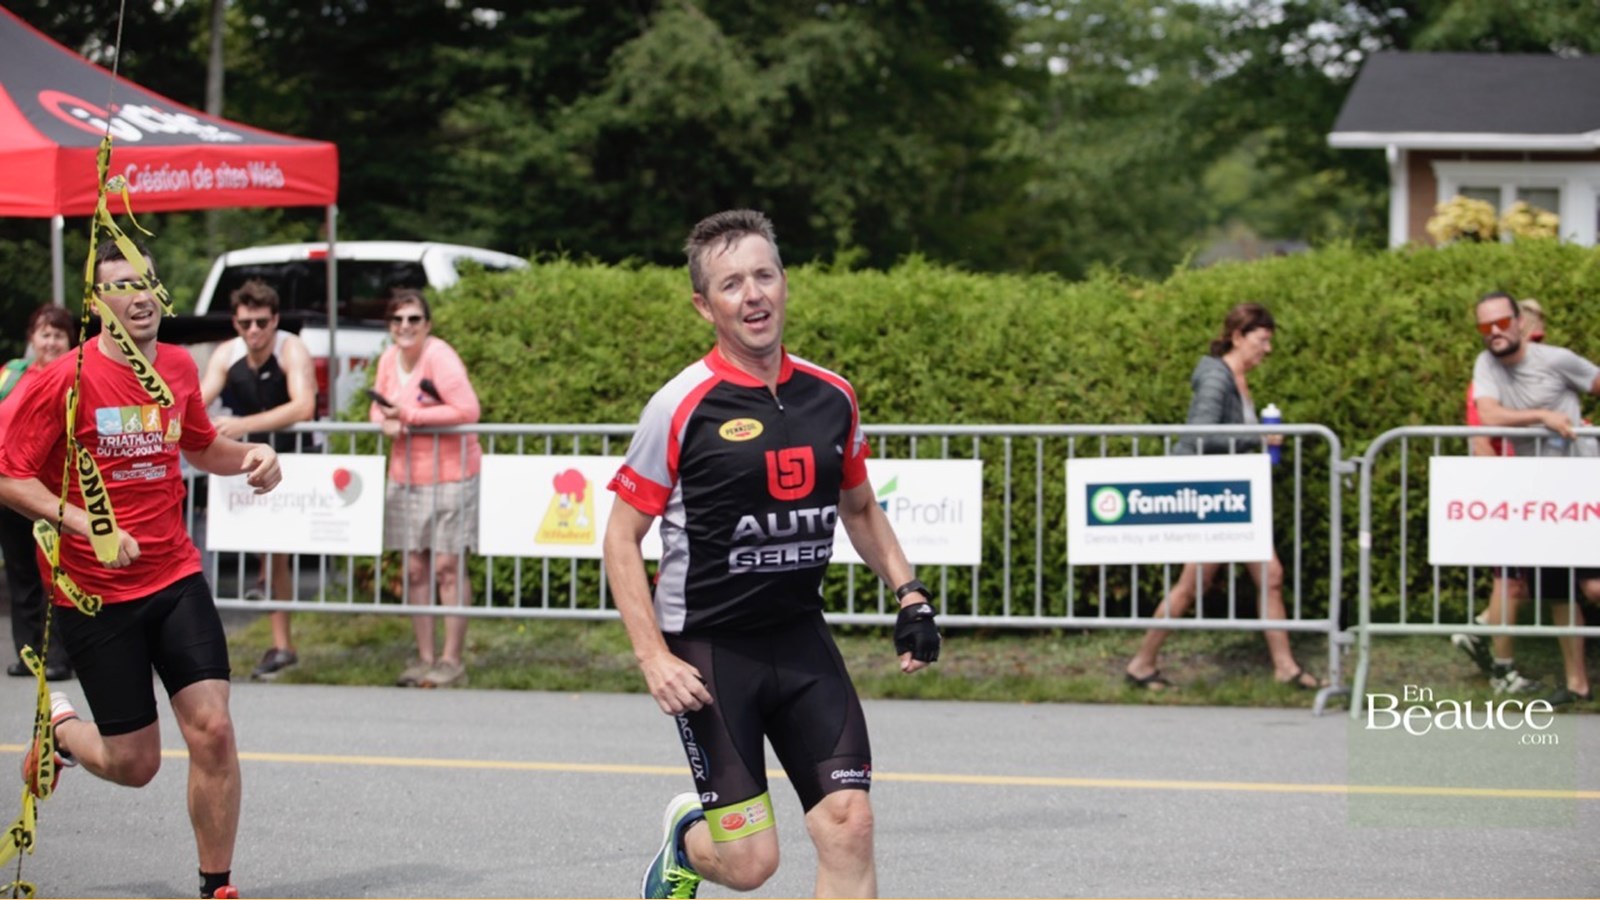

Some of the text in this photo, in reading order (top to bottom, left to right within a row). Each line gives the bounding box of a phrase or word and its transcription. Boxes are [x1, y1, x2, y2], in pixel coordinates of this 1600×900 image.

[125, 160, 285, 193] Création de sites Web
[96, 447, 112, 456] DU
[97, 431, 164, 447] TRIATHLON
[895, 497, 964, 525] Profil
[1127, 487, 1248, 520] familiprix
[731, 505, 838, 541] AUTO
[677, 712, 706, 781] ACIEUX
[831, 768, 865, 780] Global
